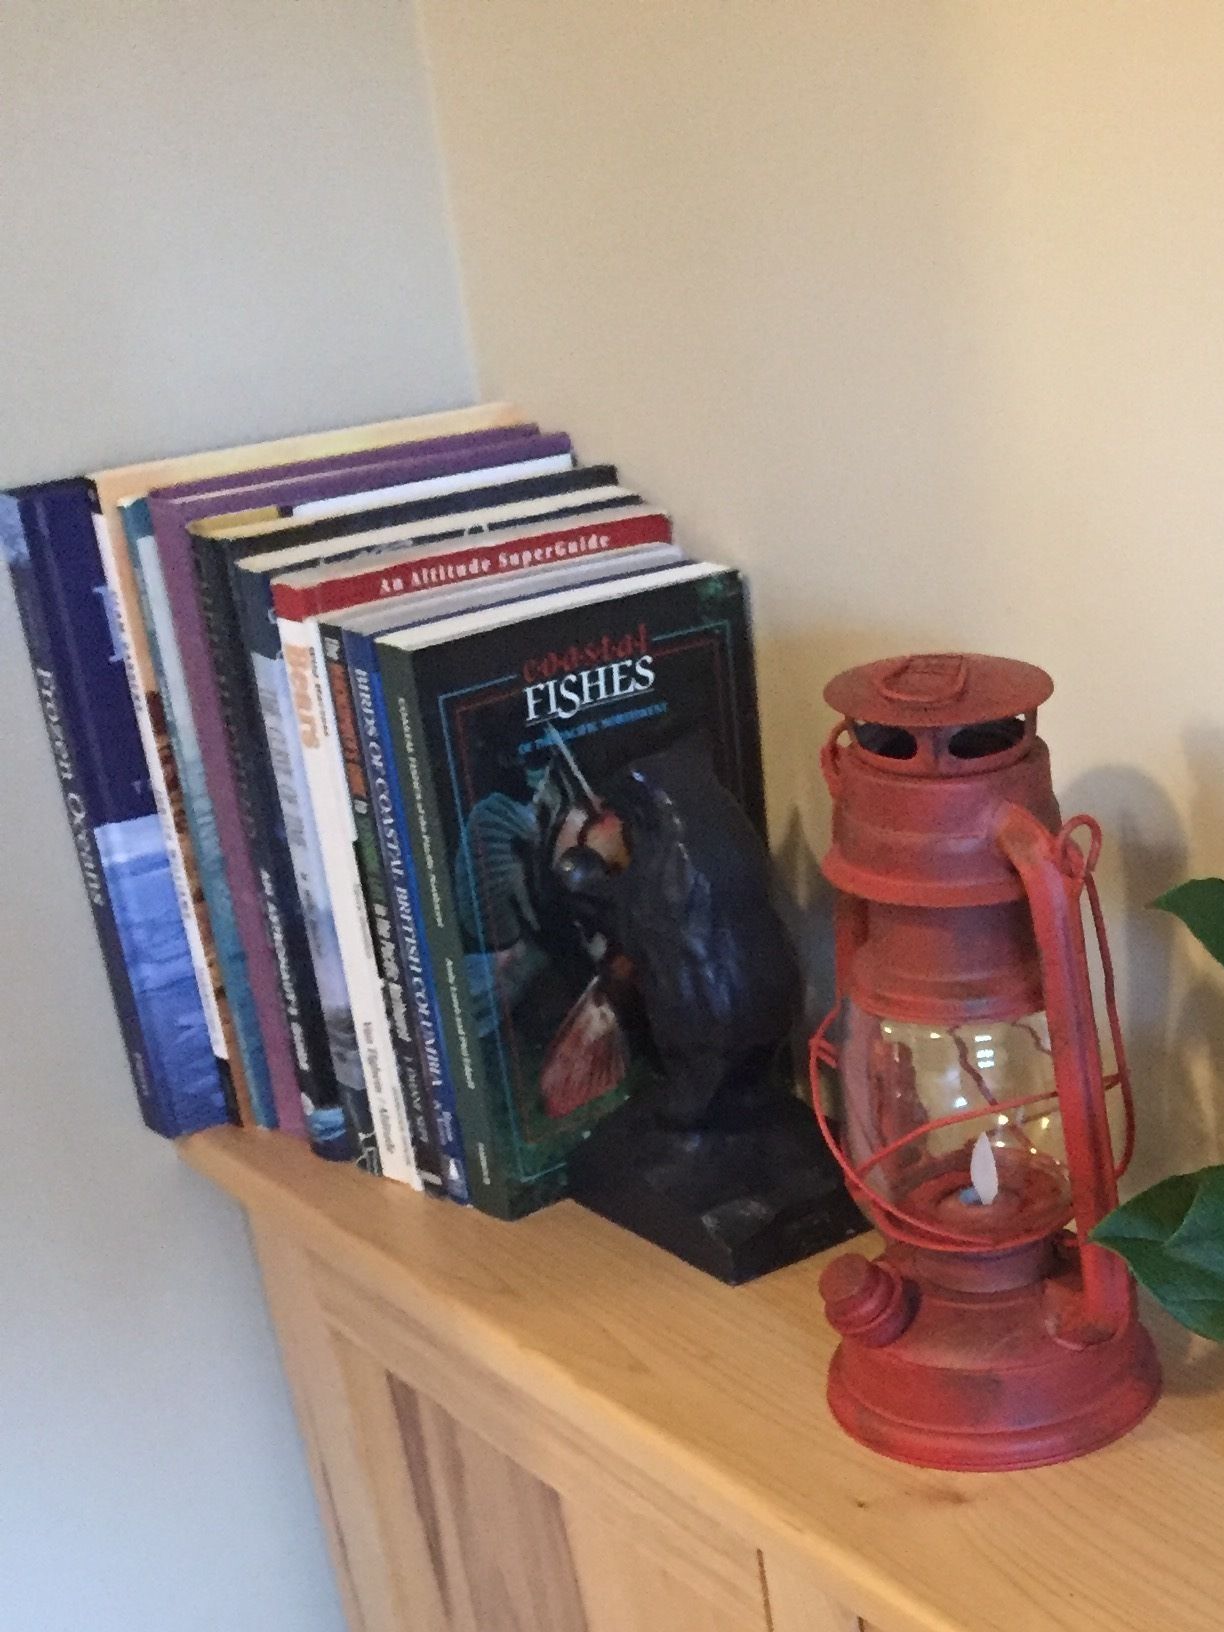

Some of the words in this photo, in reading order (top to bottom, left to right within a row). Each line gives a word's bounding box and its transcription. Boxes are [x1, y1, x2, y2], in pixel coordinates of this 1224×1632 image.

[379, 577, 403, 595] An
[411, 558, 492, 587] Altitude
[498, 534, 610, 568] SuperGuide
[522, 623, 649, 683] coastal
[523, 655, 656, 721] FISHES
[285, 644, 319, 748] Bears
[355, 668, 377, 737] BIRDS
[36, 668, 74, 777] Frozen
[67, 793, 105, 904] Oceans
[368, 742, 384, 774] OF
[375, 778, 404, 879] COASTAL
[395, 885, 421, 972] BRITISH
[412, 977, 442, 1085] COLUMBIA
